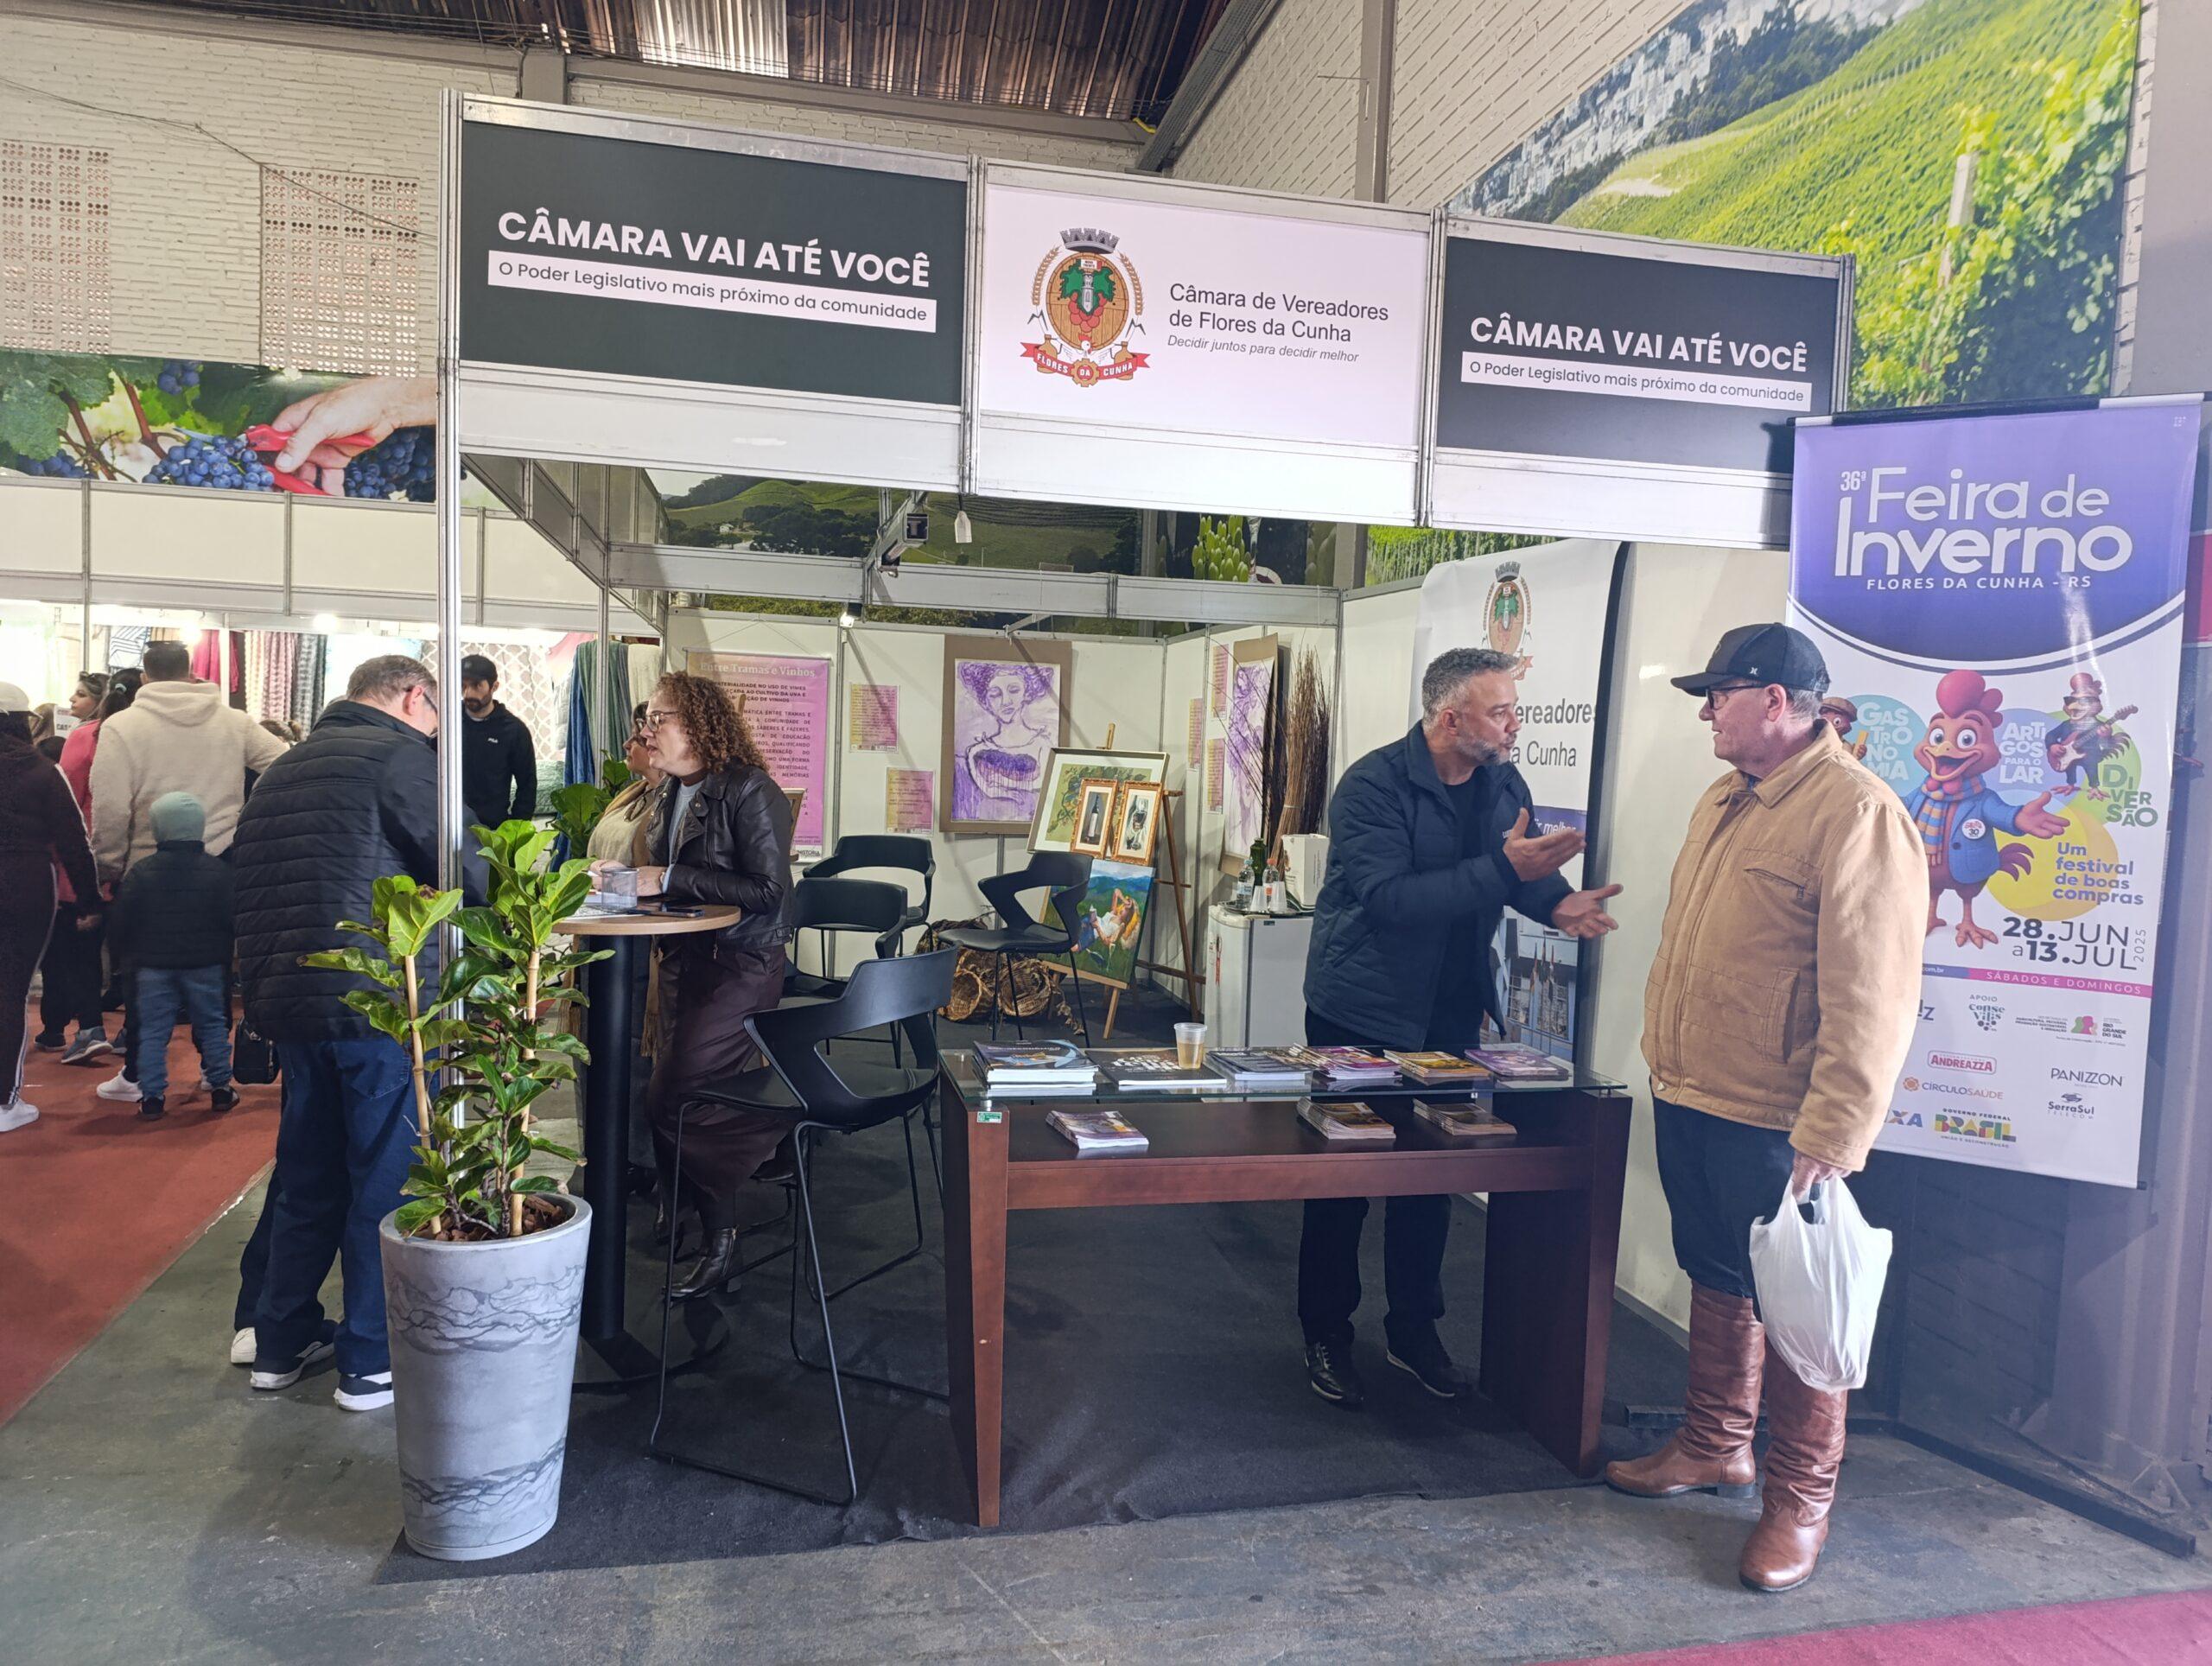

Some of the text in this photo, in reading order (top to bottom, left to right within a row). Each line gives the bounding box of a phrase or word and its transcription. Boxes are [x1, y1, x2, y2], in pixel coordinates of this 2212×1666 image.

[499, 207, 930, 288] CÂMARA VAI ATÉ VOCÊ
[499, 262, 926, 321] O Poder Legislativo mais próximo da comunidade
[1170, 283, 1389, 321] Câmara de Vereadores
[1169, 310, 1351, 342] de Flores da Cunha
[1168, 336, 1359, 362] Decidir juntos para decidir melhor
[1471, 312, 1807, 372] CÂMARA VAI ATÉ VOCÊ
[1038, 353, 1068, 373] FLORES
[1103, 362, 1133, 376] CUNHA
[1470, 361, 1803, 401] O Poder Legislativo mais próximo da comunidade
[1869, 467, 2028, 523] Feira
[2040, 474, 2109, 517] de
[1835, 497, 2133, 576] Inverno
[1867, 578, 1934, 590] FLORES
[1943, 577, 1967, 589] DA
[1977, 576, 2044, 589] CUNHA
[2069, 575, 2091, 588] RS
[701, 663, 729, 672] Entre
[732, 664, 769, 674] Tramas
[779, 666, 816, 677] Vinhos
[1515, 697, 1595, 724] ereadore
[1857, 702, 1910, 727] GAS
[1870, 726, 1913, 746] TRO
[2003, 722, 2046, 741] ARTI
[1527, 741, 1576, 766] Cunha
[1866, 745, 1897, 761] NO
[1999, 740, 2044, 758] GOS
[2005, 757, 2031, 766] PARA
[1999, 766, 2044, 785] LAR
[2110, 789, 2152, 810] VER
[2105, 807, 2158, 827] SÃO
[2057, 842, 2087, 856] Um
[2056, 855, 2133, 875] festival
[2055, 872, 2130, 890] de boas
[2052, 887, 2144, 906] compras
[2012, 944, 2024, 958] a
[2133, 928, 2147, 963] 2025
[1986, 970, 2142, 995] SÁBADOS E DOMINGOS
[1969, 994, 1998, 1002] APOIO
[1931, 1054, 1993, 1071] ANDREAZZA
[2050, 1068, 2122, 1087] PANIZZON
[1942, 1108, 1976, 1116] GOVERNO
[2048, 1101, 2094, 1115] SerraSul
[1935, 1114, 2016, 1142] BRASIL
